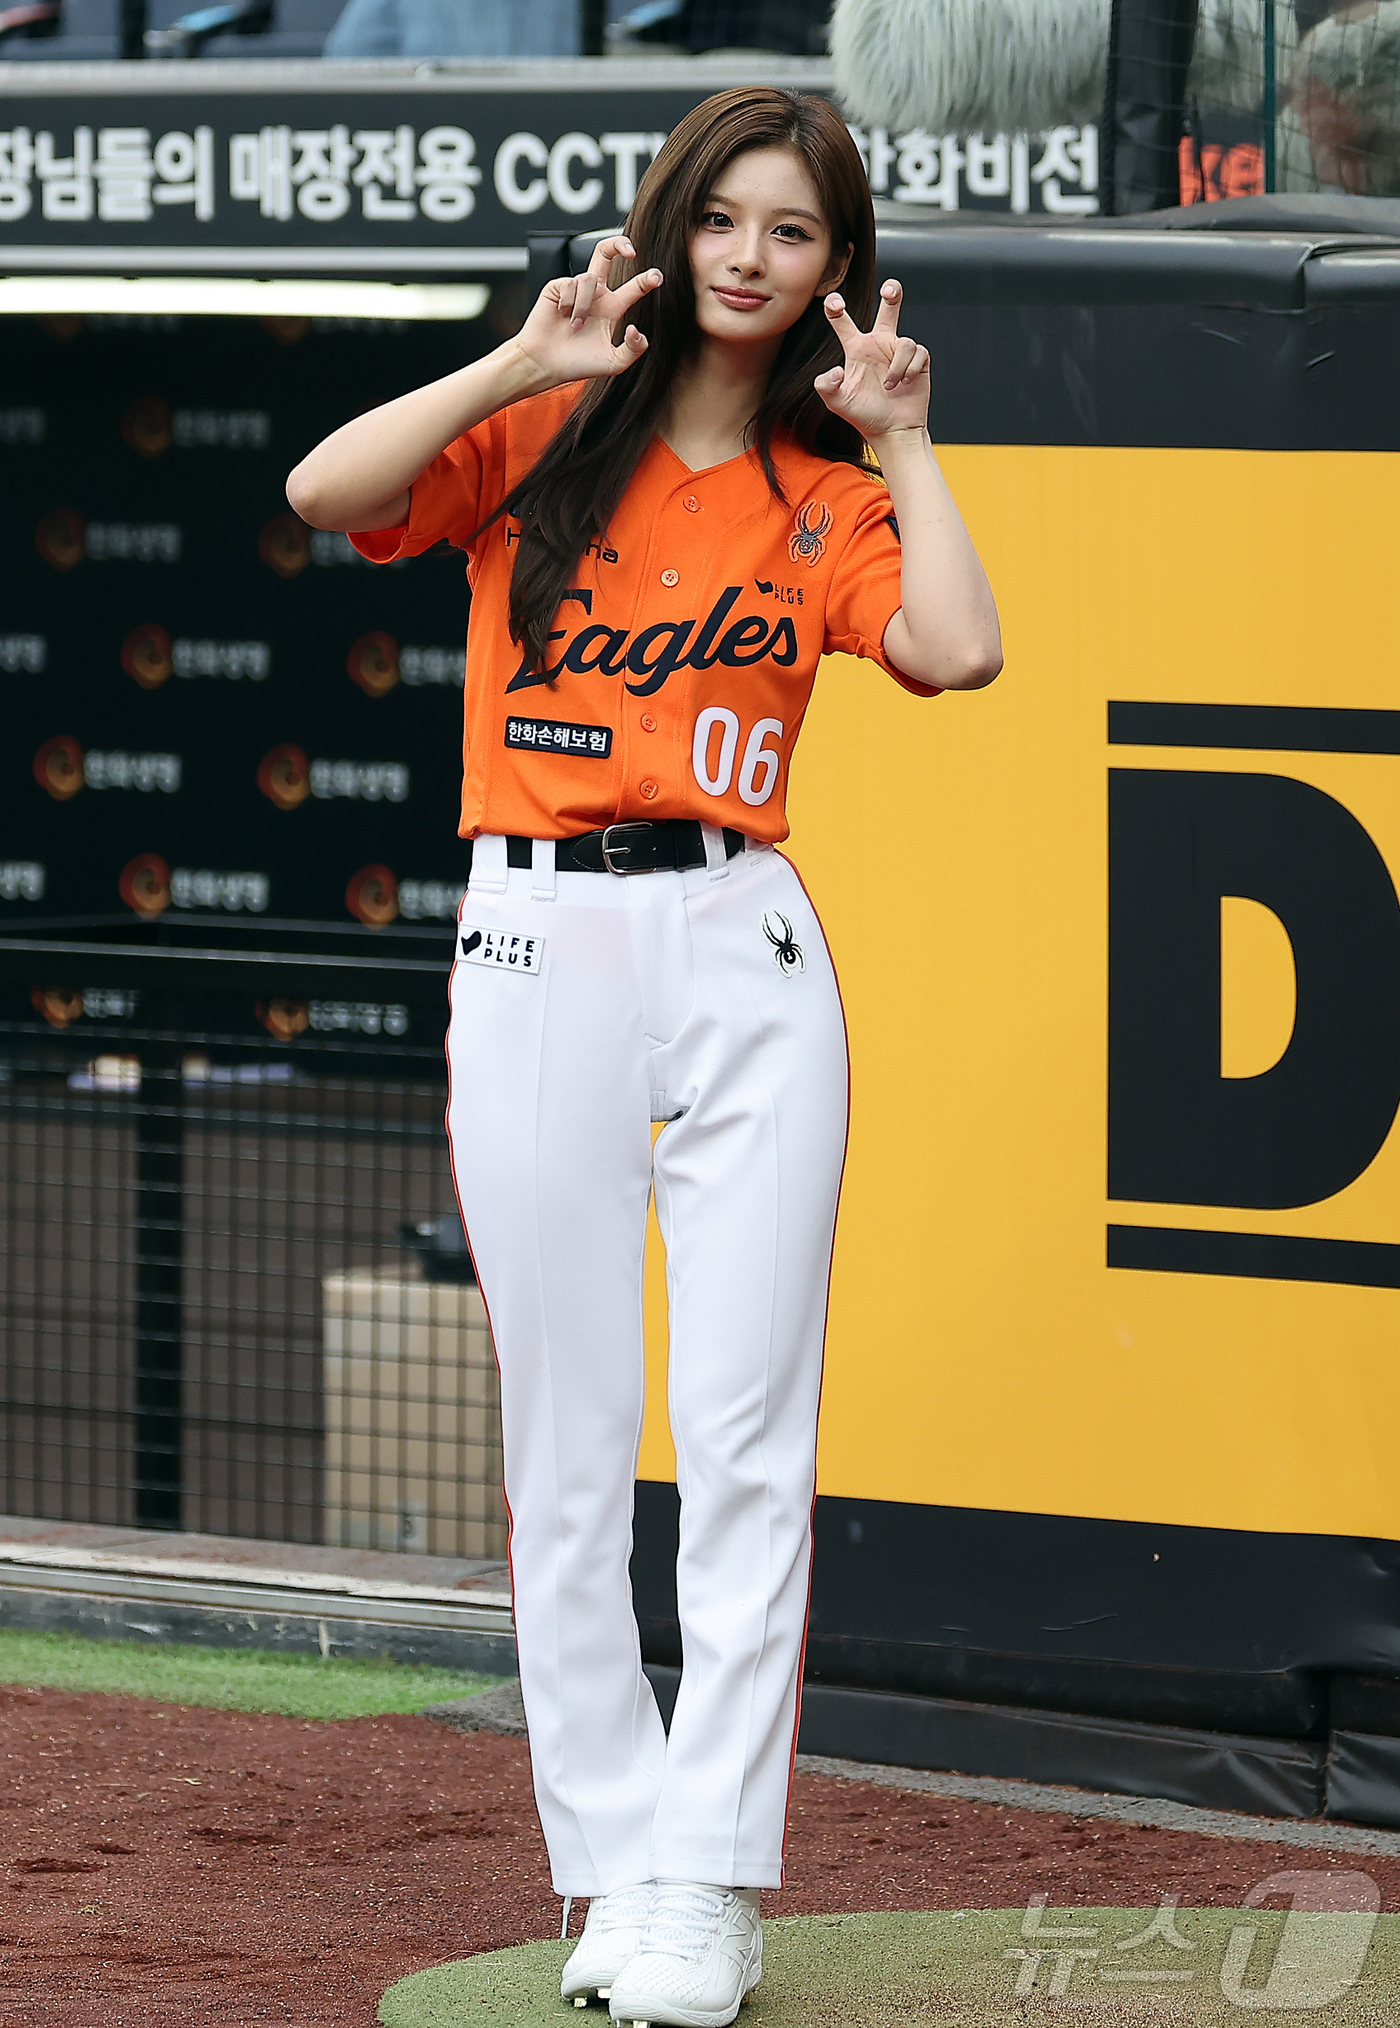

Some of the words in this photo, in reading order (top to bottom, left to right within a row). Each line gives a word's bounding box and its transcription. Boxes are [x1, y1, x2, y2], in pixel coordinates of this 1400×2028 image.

[229, 124, 482, 221] 매장전용
[774, 583, 804, 597] LIFE
[774, 591, 804, 606] PLUS
[504, 586, 798, 697] Eagles
[508, 721, 608, 752] 한화손해보험
[692, 706, 784, 807] 06
[483, 947, 532, 968] PLUS
[486, 933, 535, 953] LIFE
[1107, 767, 1400, 1212] D
